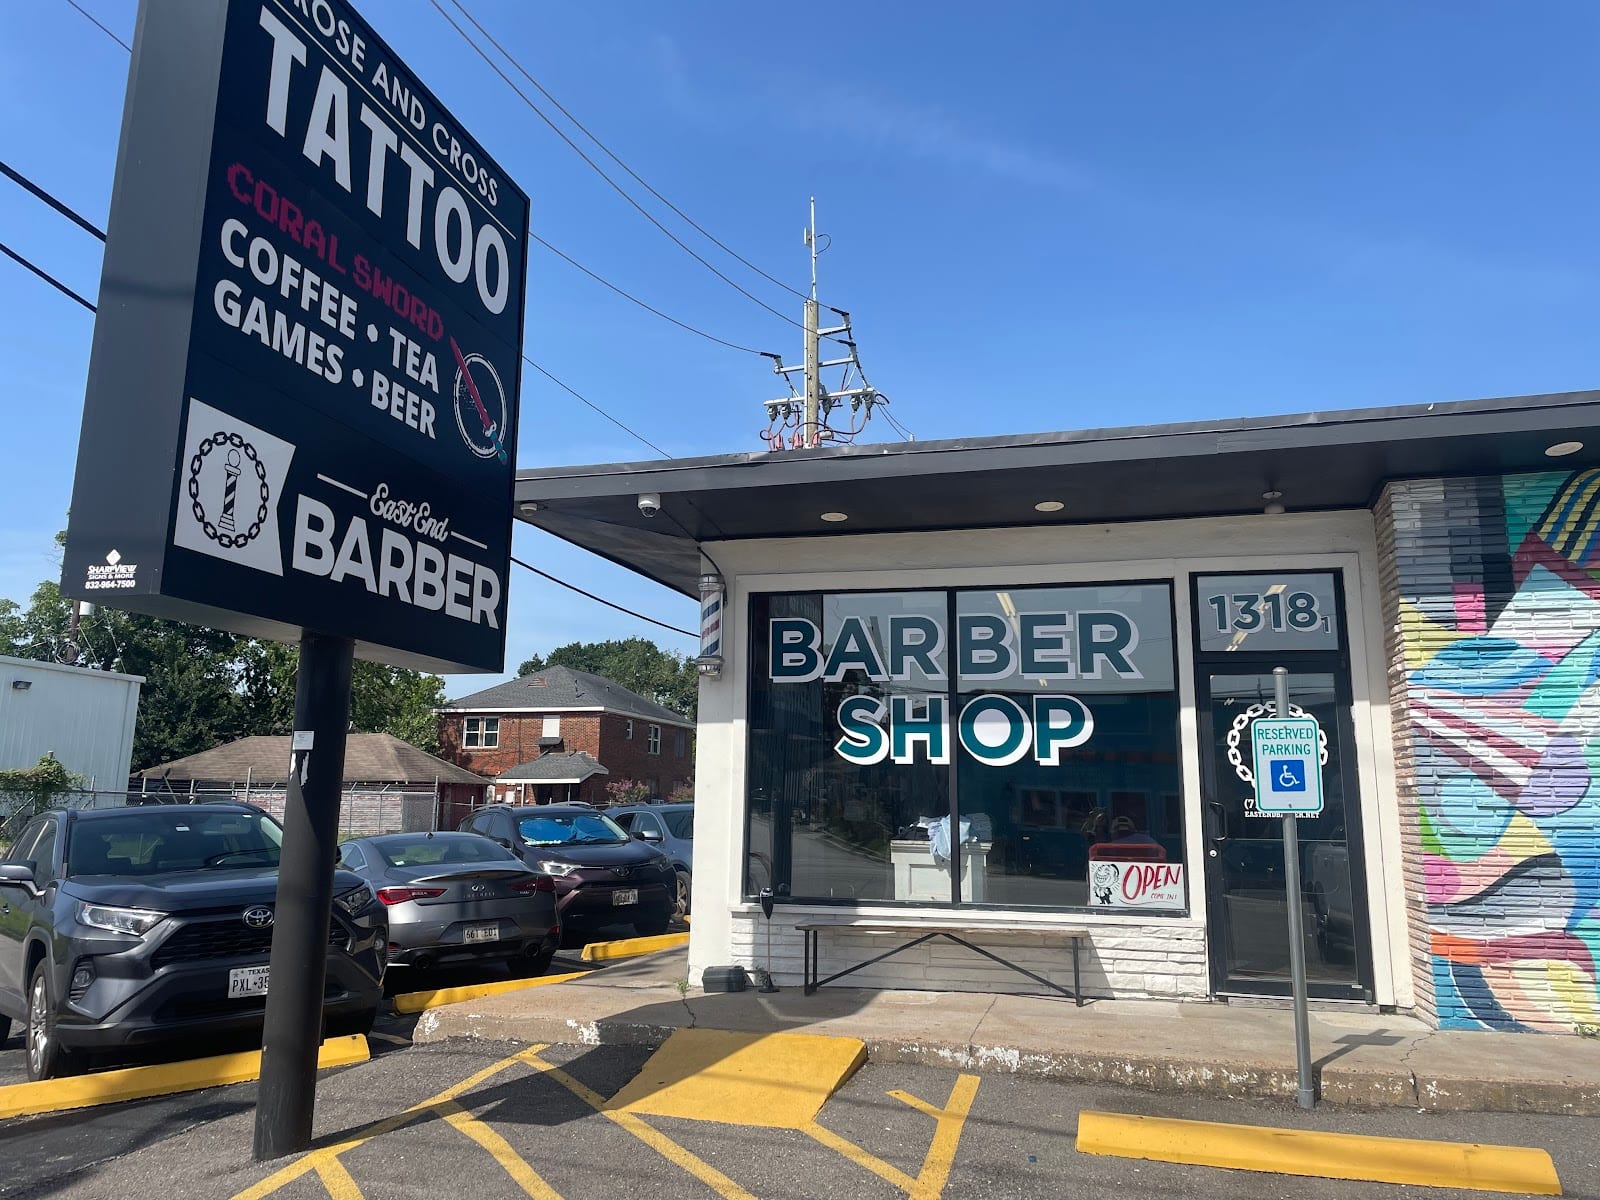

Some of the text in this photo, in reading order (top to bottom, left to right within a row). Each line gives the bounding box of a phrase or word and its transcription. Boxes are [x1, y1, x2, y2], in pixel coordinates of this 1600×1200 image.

[259, 5, 509, 315] TATTOO
[371, 62, 426, 130] AND
[432, 122, 498, 206] CROSS
[227, 162, 444, 342] CORAL SWORD
[220, 218, 439, 394] COFFEE TEA
[213, 279, 436, 440] GAMES BEER
[370, 482, 450, 542] East End
[85, 580, 136, 589] 832-964-7500
[292, 493, 500, 630] BARBER
[768, 609, 1144, 683] BARBER
[1208, 591, 1322, 634] 1318
[834, 693, 1094, 766] SHOP
[1257, 728, 1313, 740] RESERVED
[1262, 744, 1311, 755] PARKING
[1122, 864, 1181, 900] OPEN
